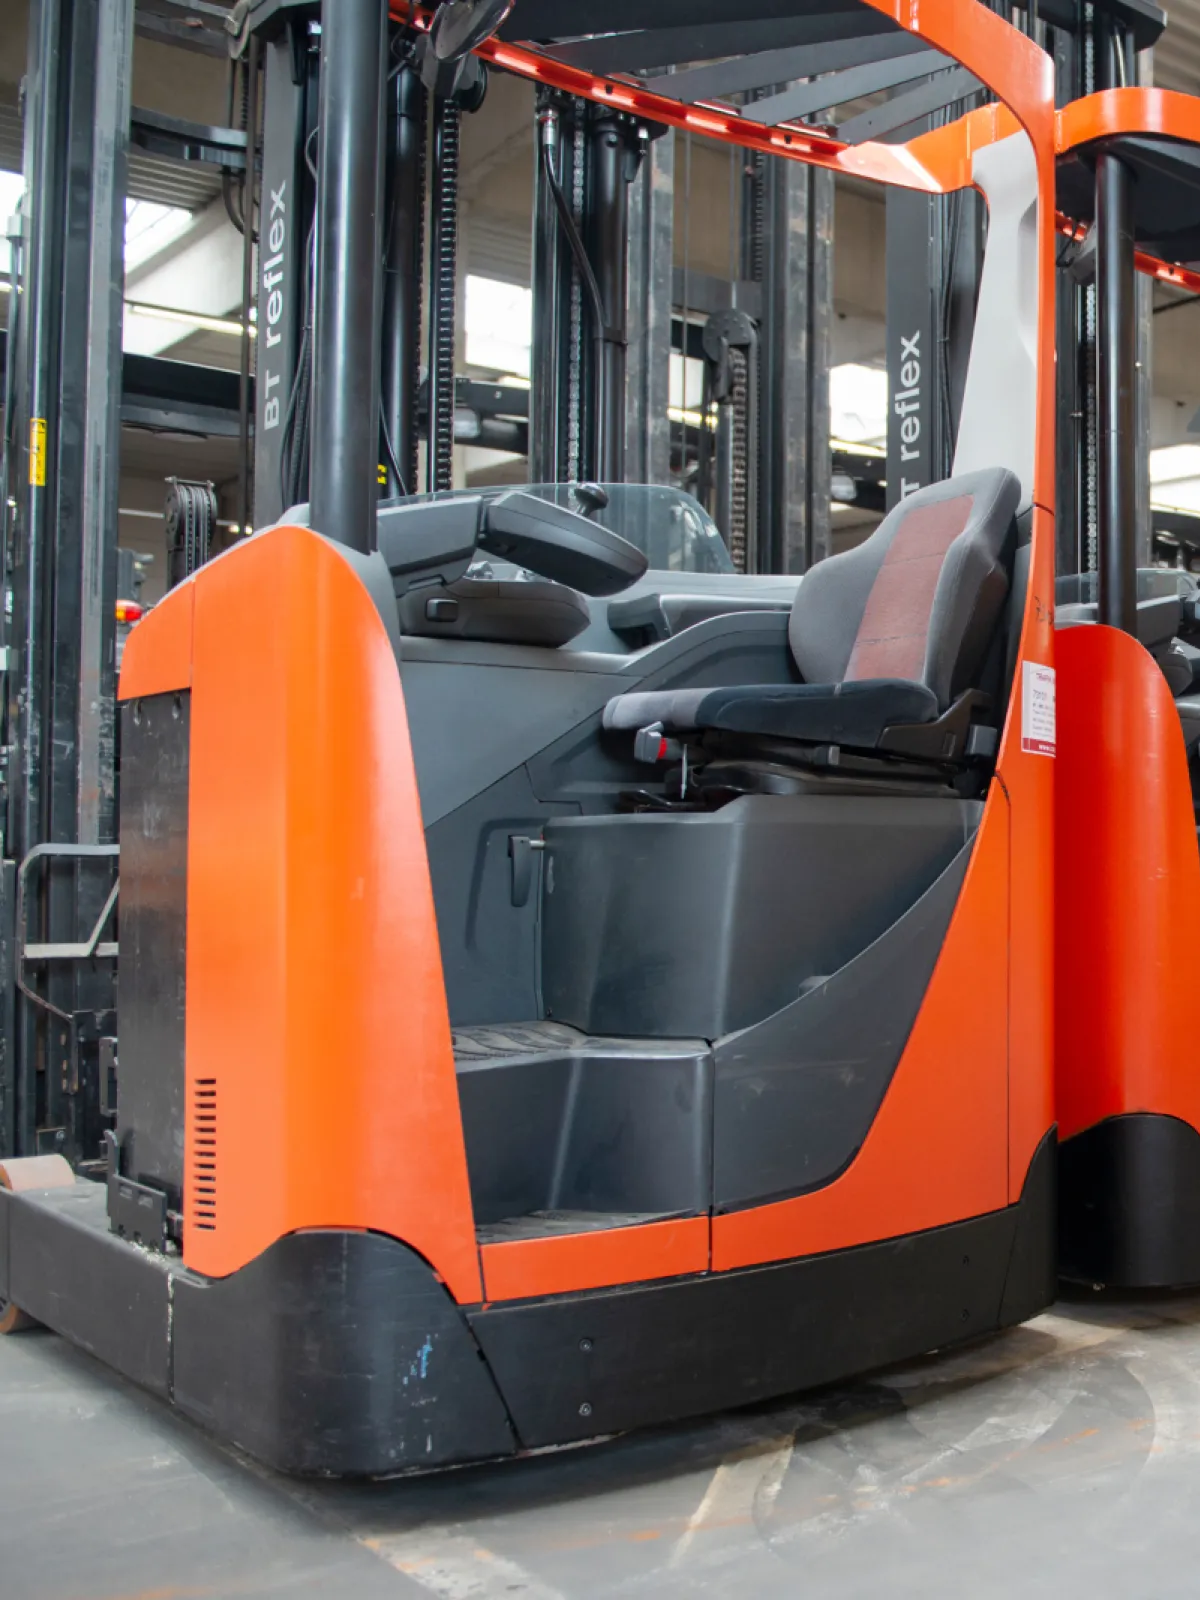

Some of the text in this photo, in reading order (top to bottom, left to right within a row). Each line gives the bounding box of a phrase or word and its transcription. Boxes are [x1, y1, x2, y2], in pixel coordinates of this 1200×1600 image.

[263, 179, 286, 430] BT reflex
[894, 329, 921, 462] reflex
